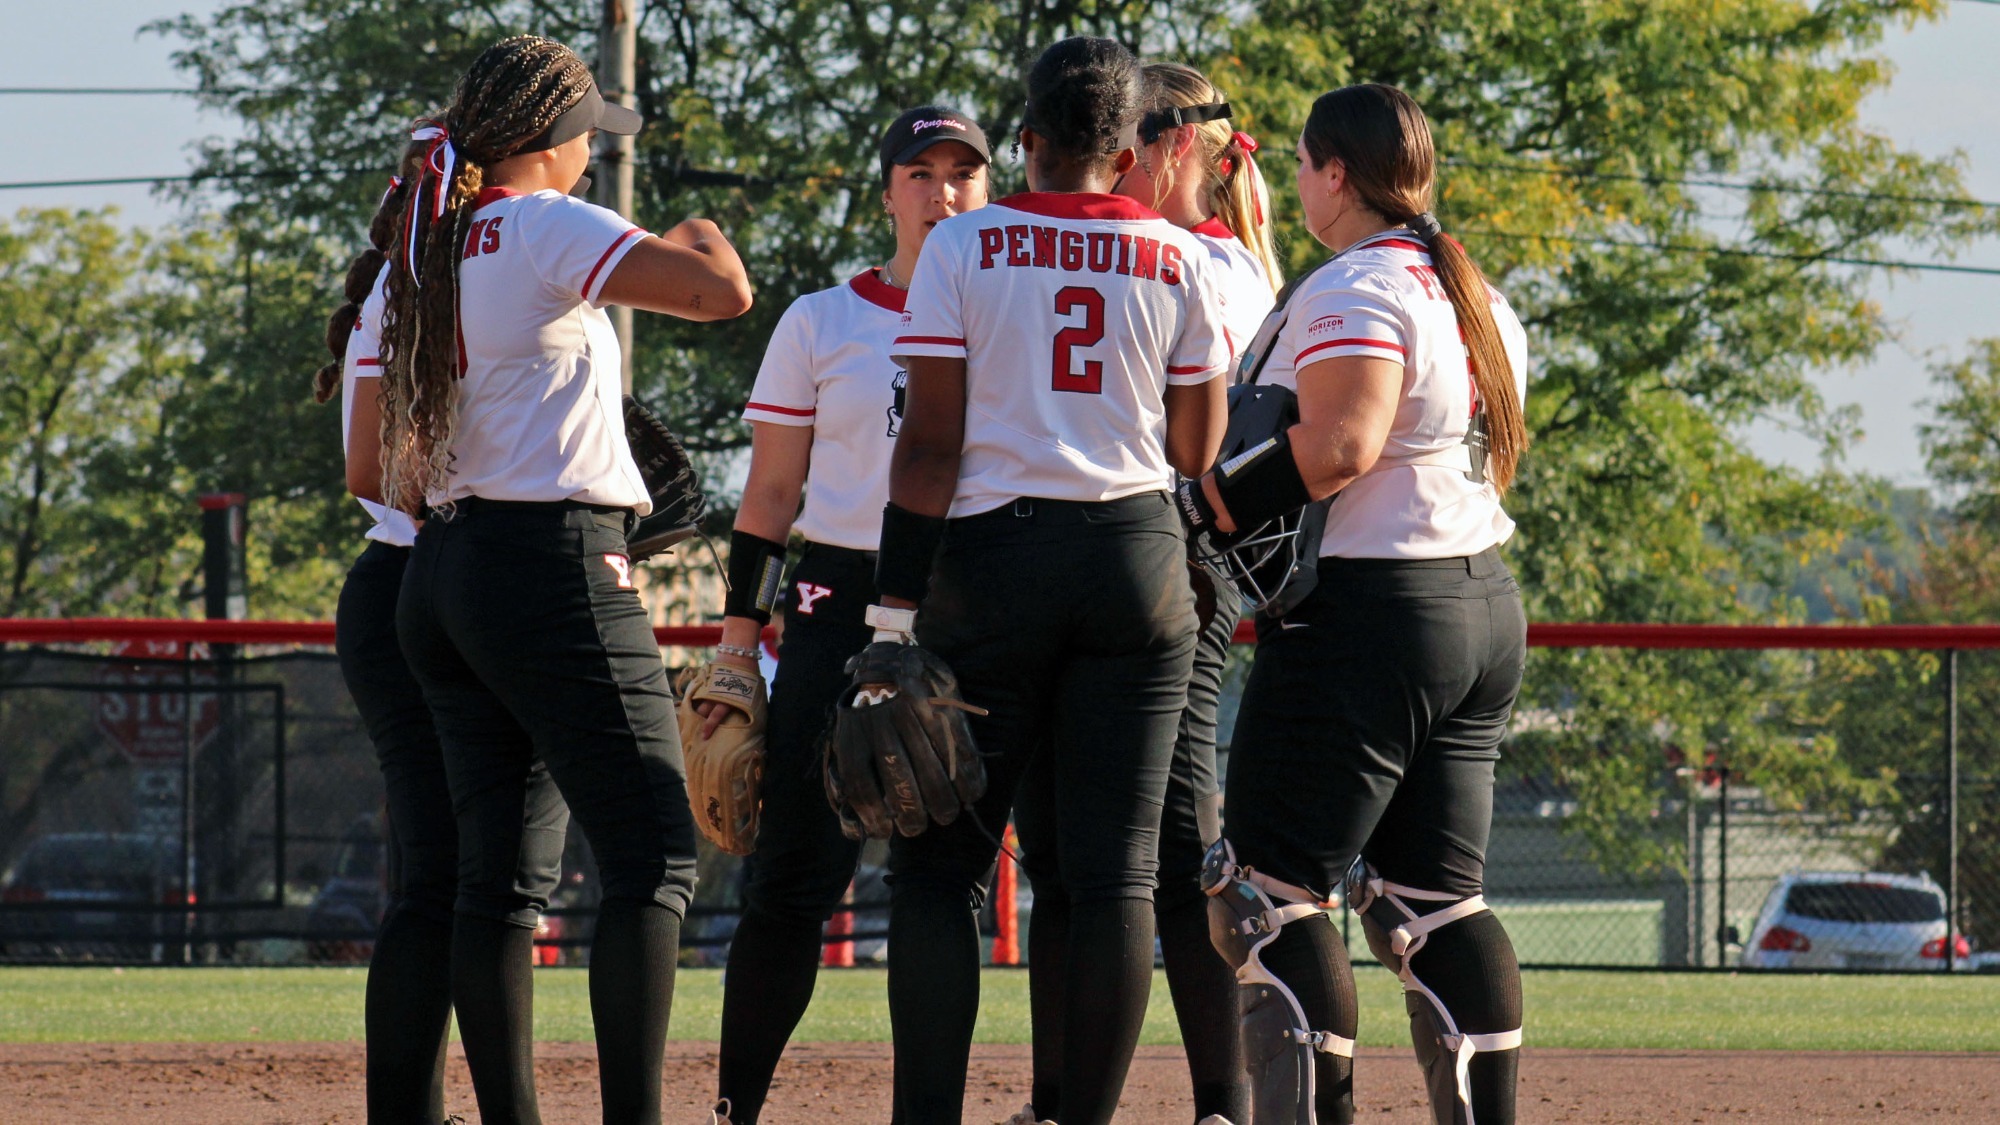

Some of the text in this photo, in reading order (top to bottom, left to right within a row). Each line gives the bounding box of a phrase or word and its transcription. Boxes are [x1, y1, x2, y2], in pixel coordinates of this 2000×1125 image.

[912, 119, 967, 135] Penguins
[979, 225, 1182, 286] PENGUINS
[1051, 285, 1106, 394] 2
[1308, 319, 1343, 334] HORIZON
[603, 553, 632, 588] Y
[796, 581, 832, 615] Y
[101, 672, 218, 721] STOP
